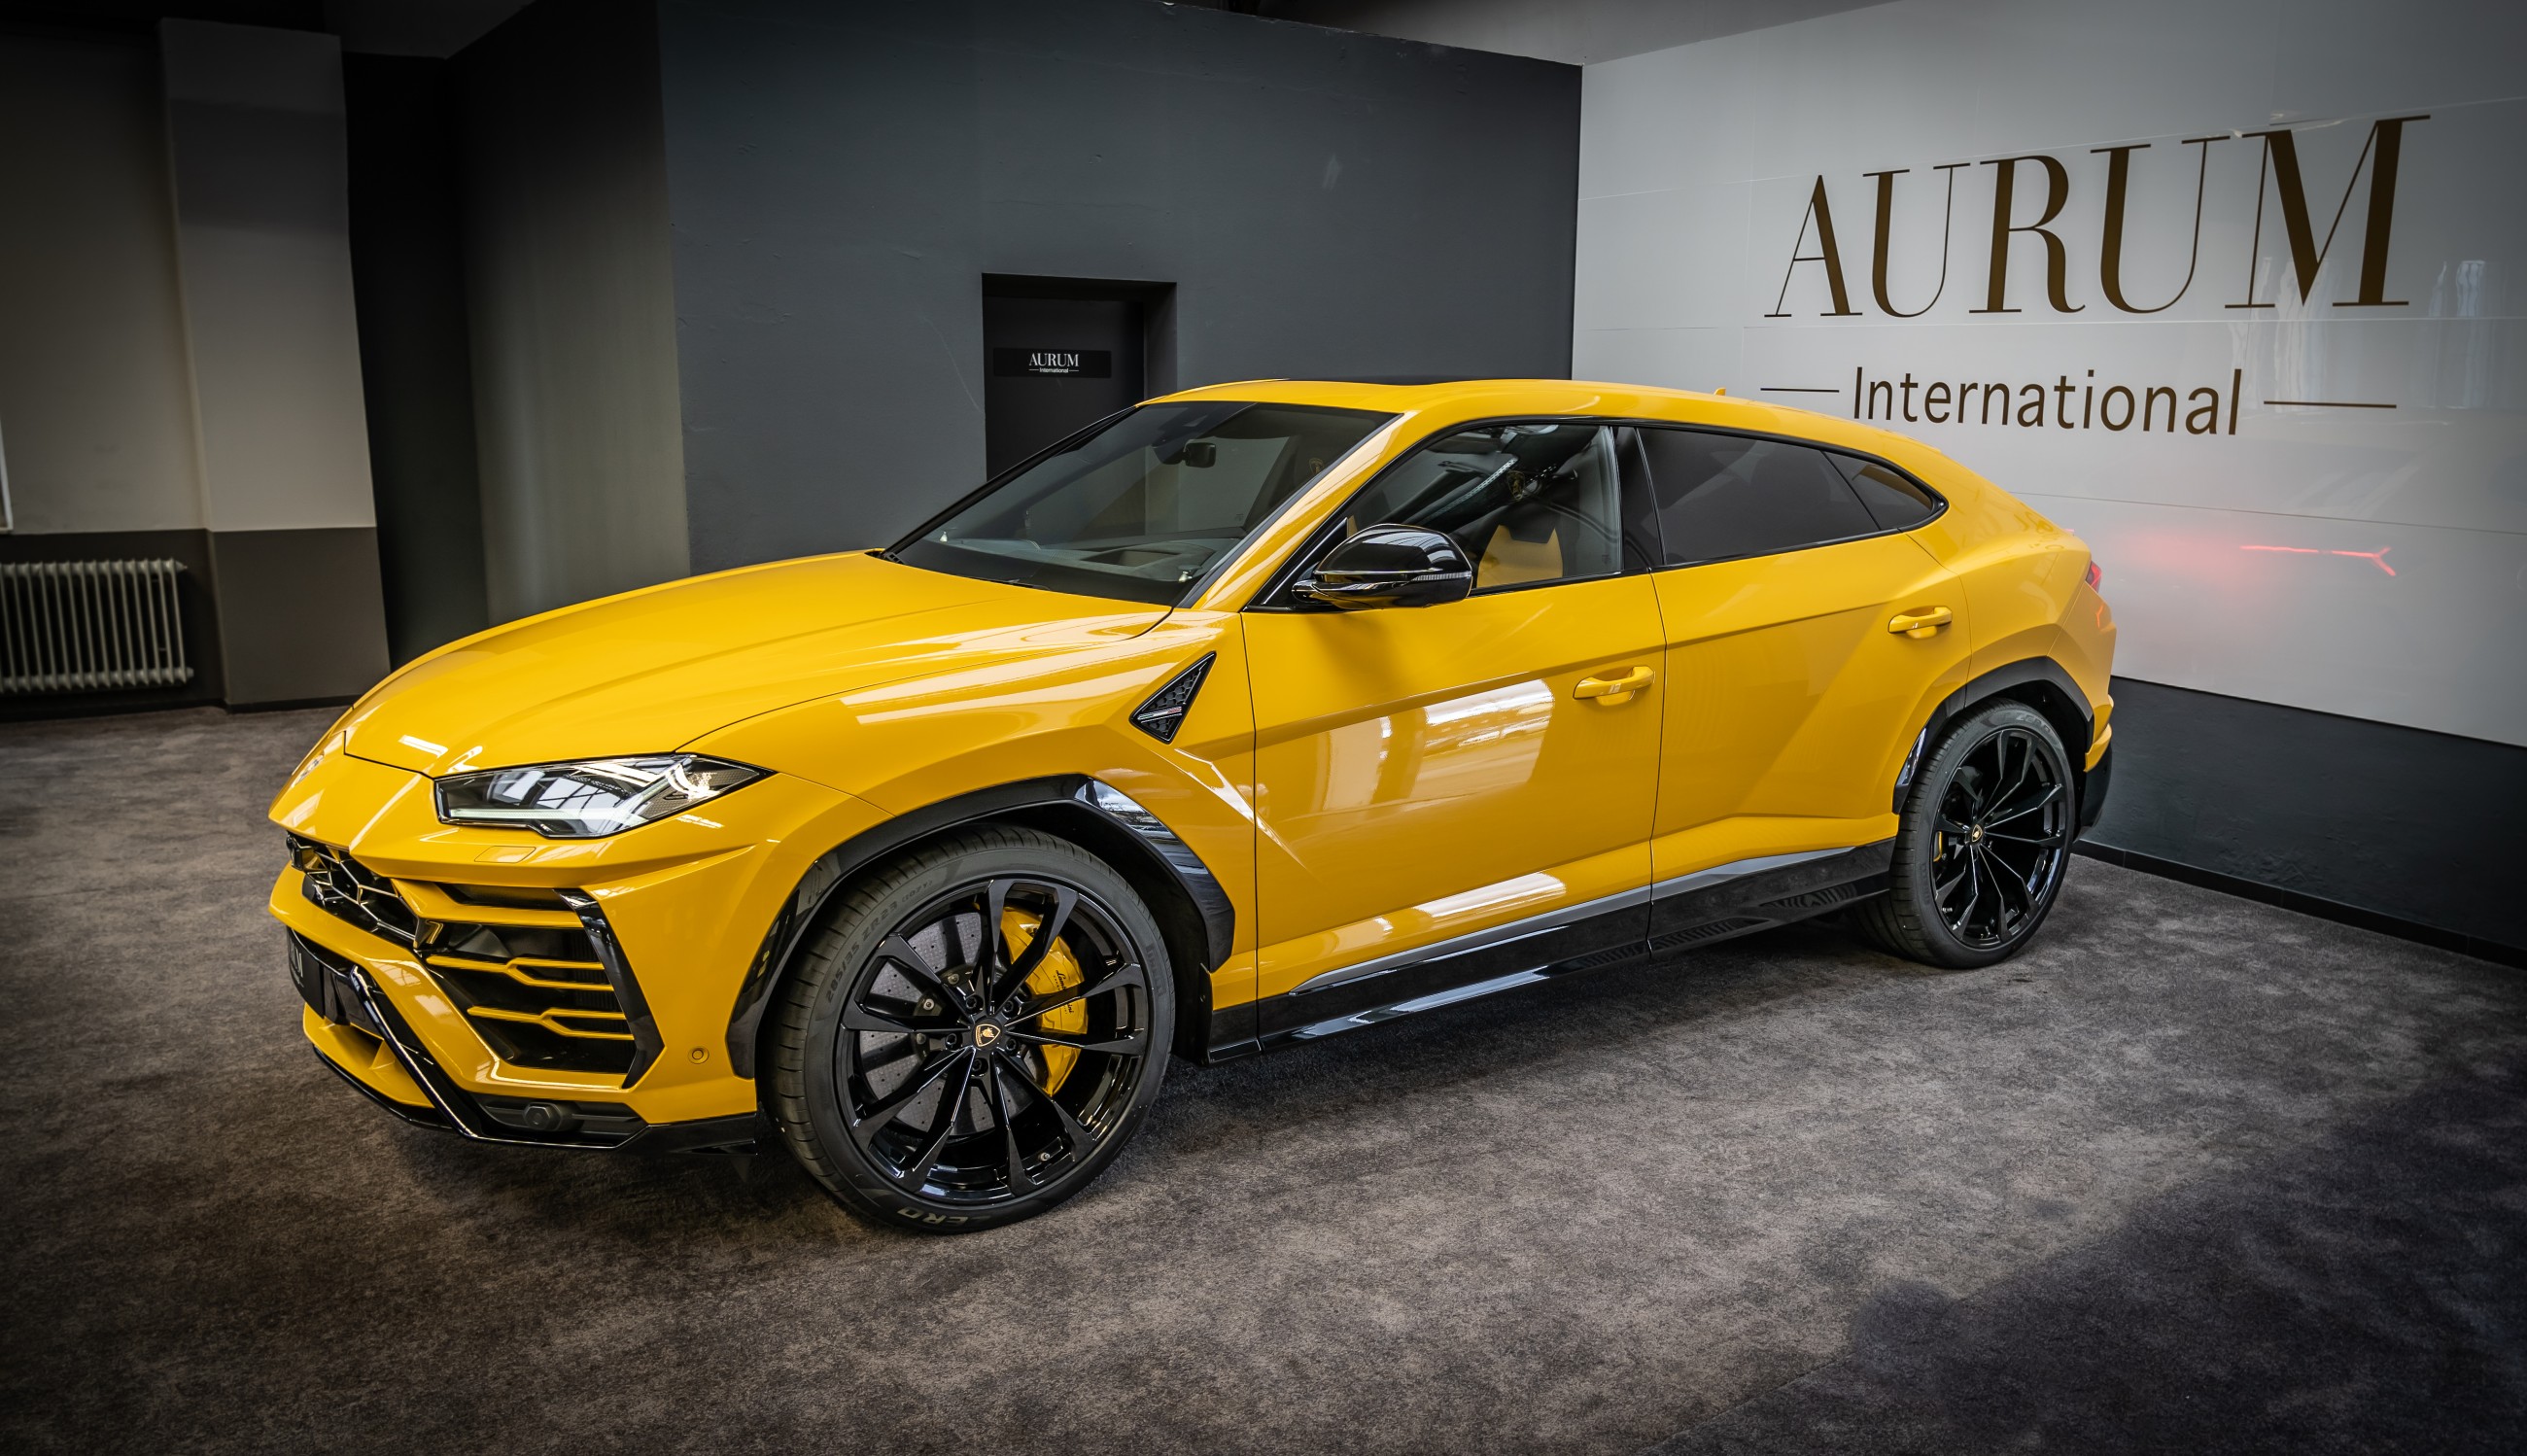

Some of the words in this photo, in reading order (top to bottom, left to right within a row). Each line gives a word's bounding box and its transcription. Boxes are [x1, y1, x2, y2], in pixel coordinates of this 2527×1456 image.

[1763, 115, 2431, 318] AURUM
[1028, 353, 1079, 367] AURUM
[1853, 366, 2242, 435] International
[826, 942, 860, 1003] 285/35
[862, 901, 898, 942] ZR23
